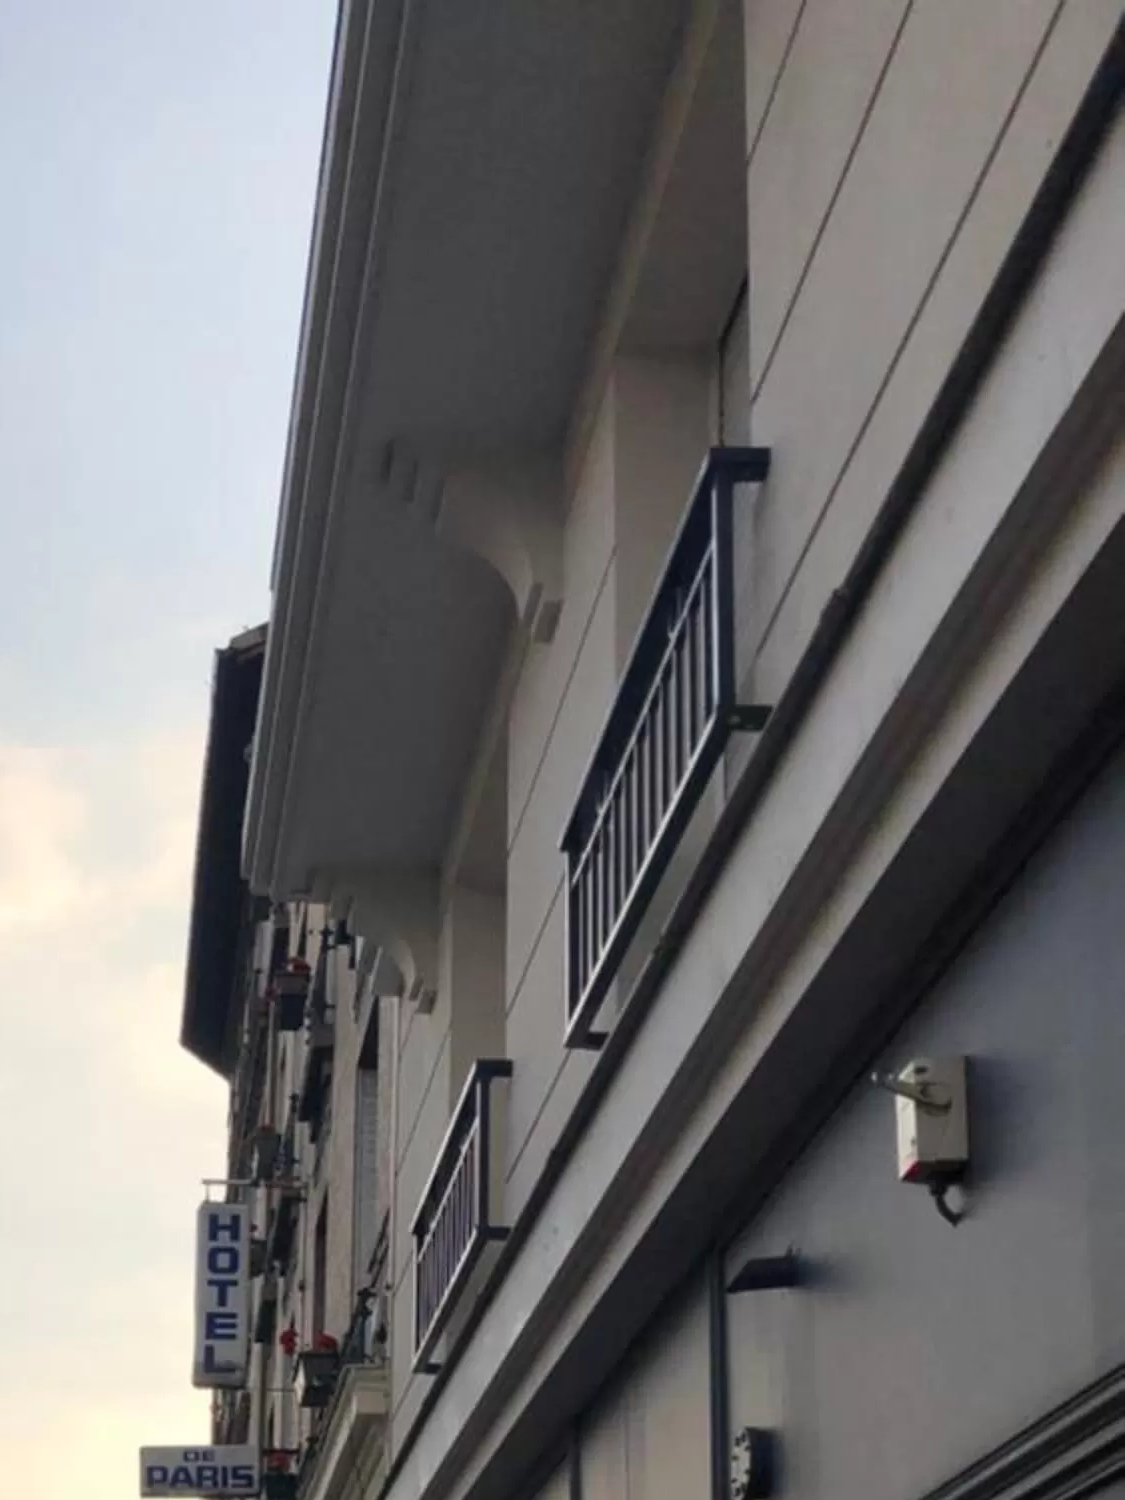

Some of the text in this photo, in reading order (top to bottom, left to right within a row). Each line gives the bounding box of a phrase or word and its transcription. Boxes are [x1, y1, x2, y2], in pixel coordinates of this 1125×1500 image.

[204, 1213, 241, 1374] HOTEL
[183, 1450, 216, 1462] DE
[146, 1465, 255, 1489] PARIS
